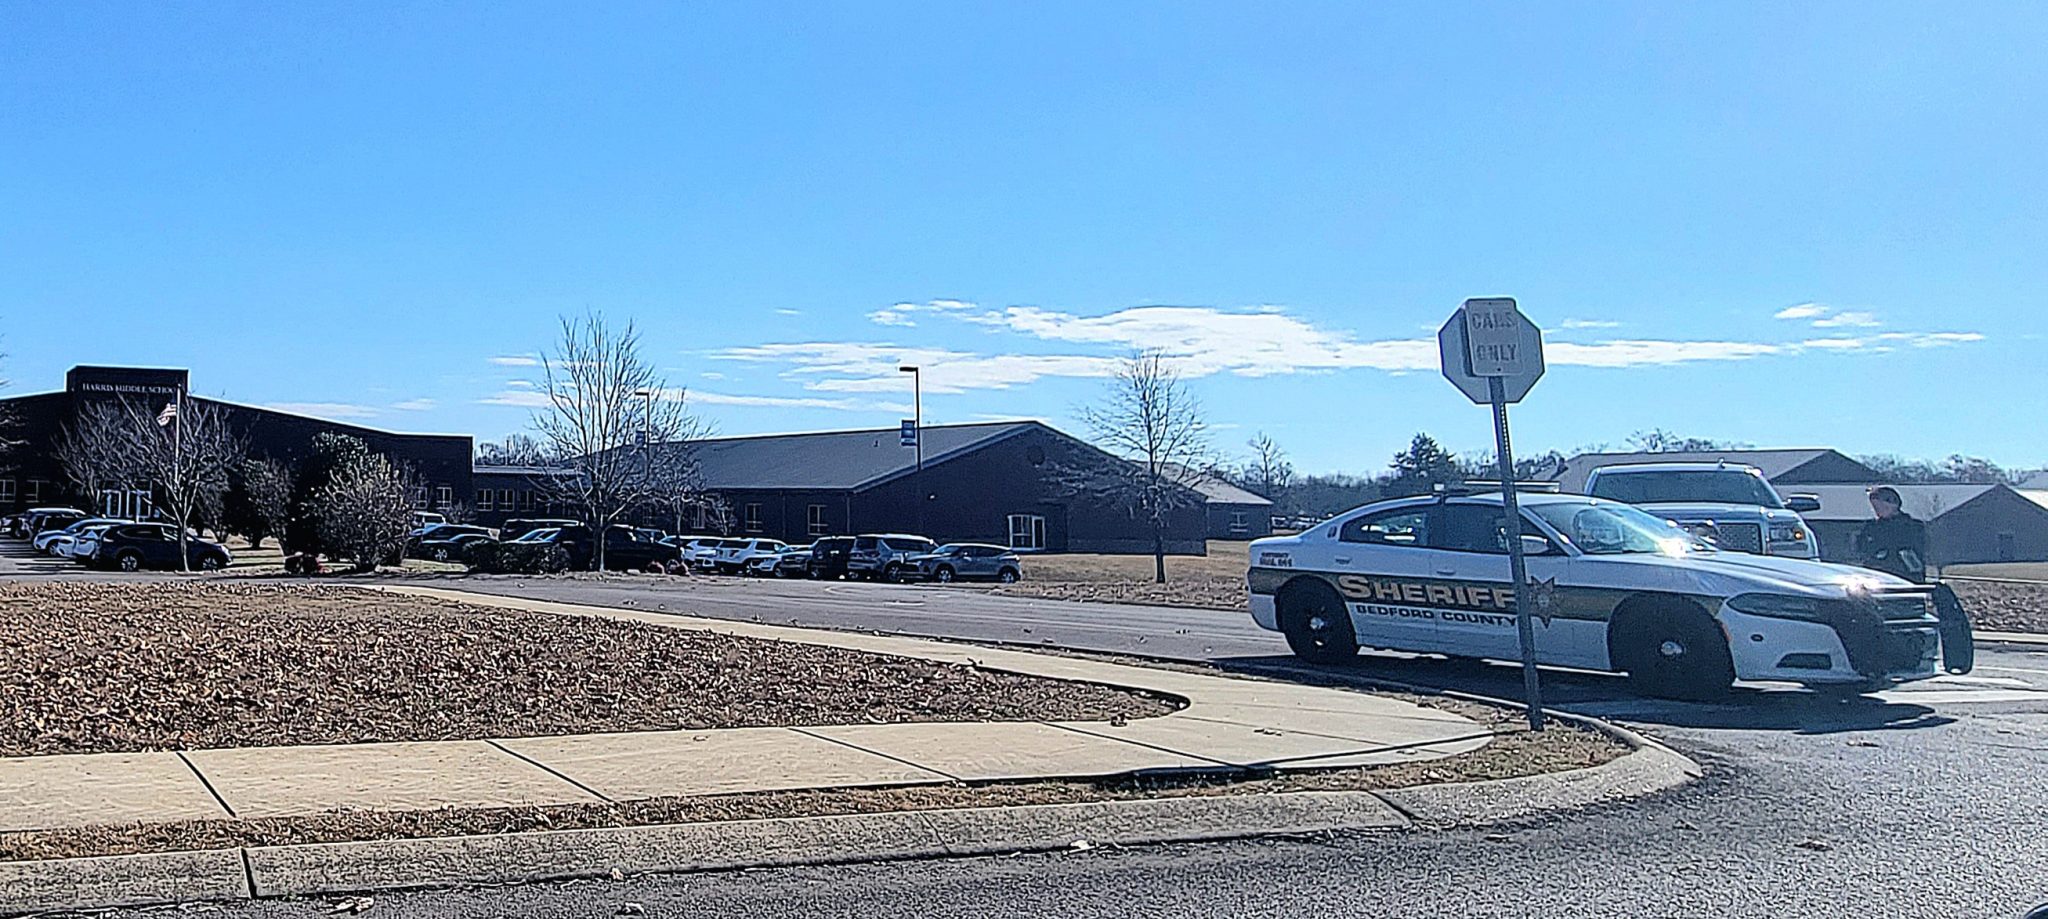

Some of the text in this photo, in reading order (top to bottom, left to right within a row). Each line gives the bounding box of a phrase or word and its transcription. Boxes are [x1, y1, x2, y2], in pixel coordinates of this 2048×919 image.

[1476, 344, 1517, 361] ONLY
[82, 383, 114, 392] HARRIS
[148, 386, 179, 395] SCHOO
[1338, 574, 1516, 609] SHERIFF
[1356, 604, 1516, 627] BEDFORD COUNTY
